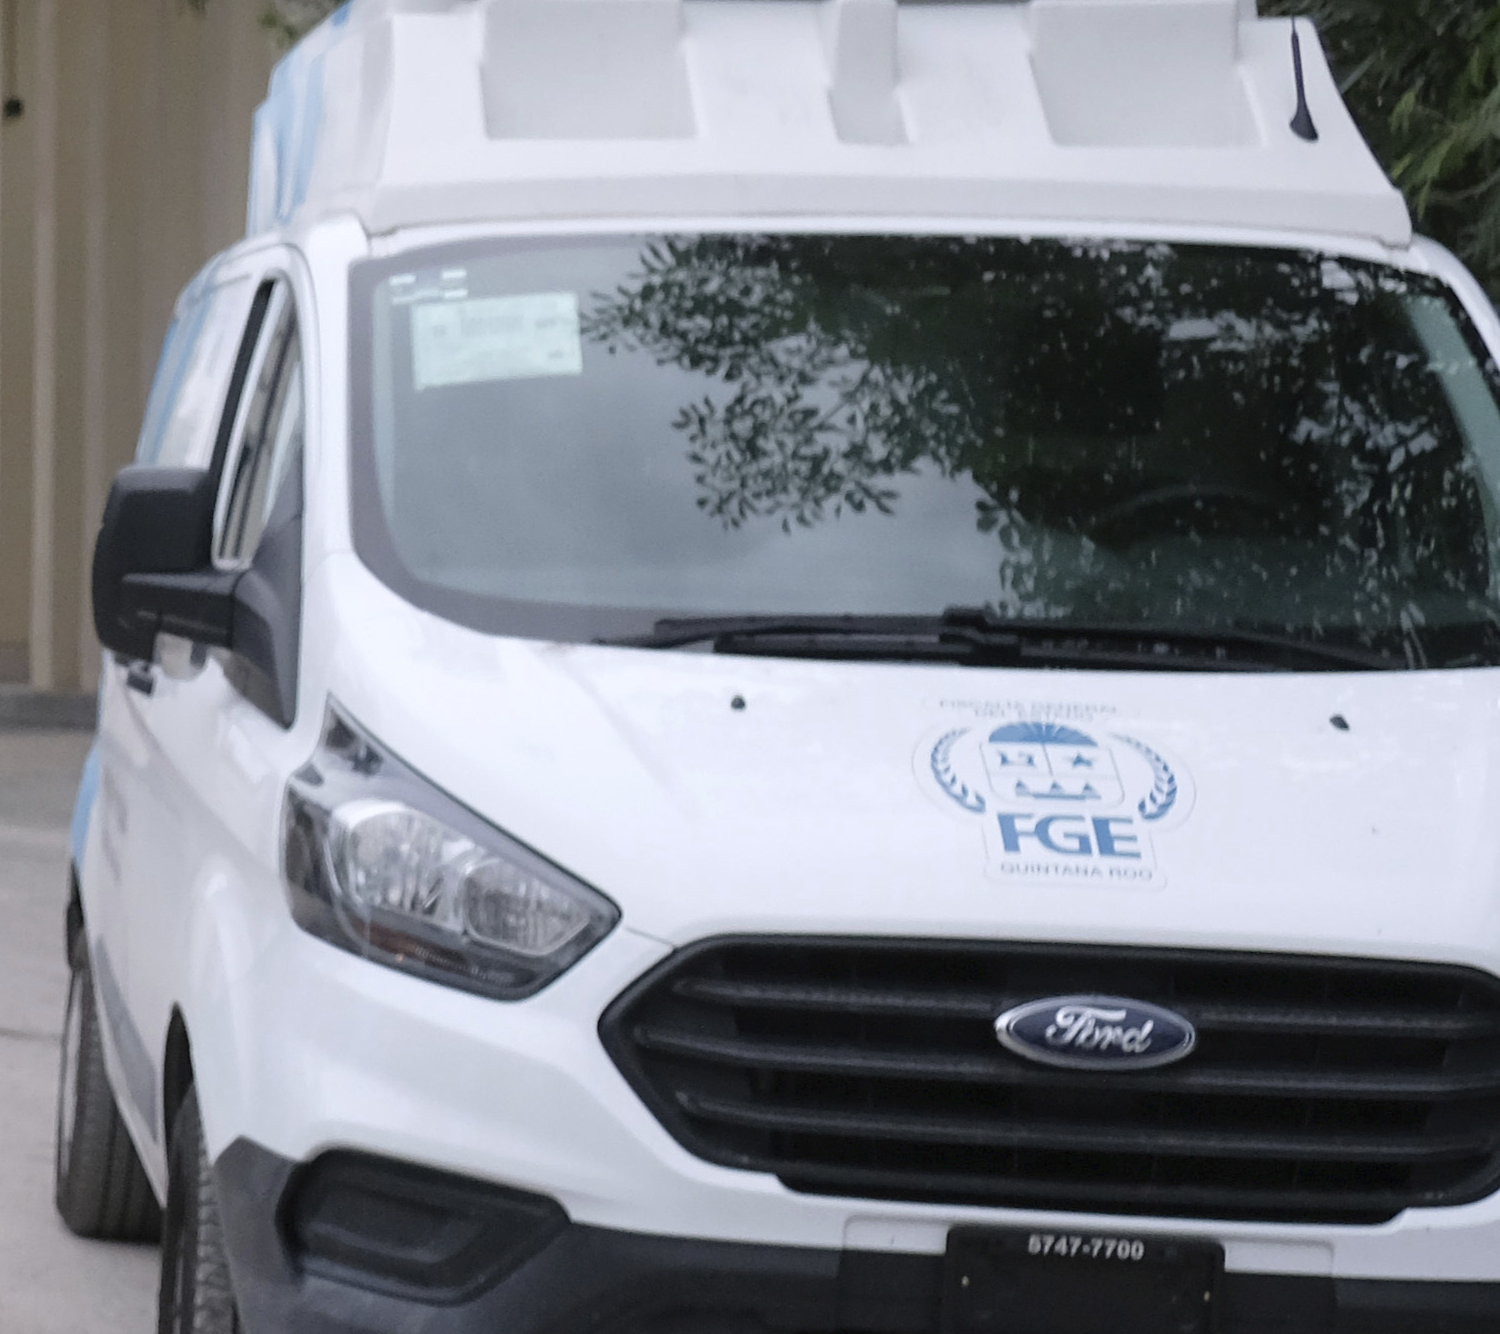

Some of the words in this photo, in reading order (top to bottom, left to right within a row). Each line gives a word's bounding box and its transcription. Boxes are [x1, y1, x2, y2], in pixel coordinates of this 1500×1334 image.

[997, 812, 1142, 859] FGE
[1000, 862, 1105, 880] QUINTANA
[1045, 1005, 1155, 1054] Ford
